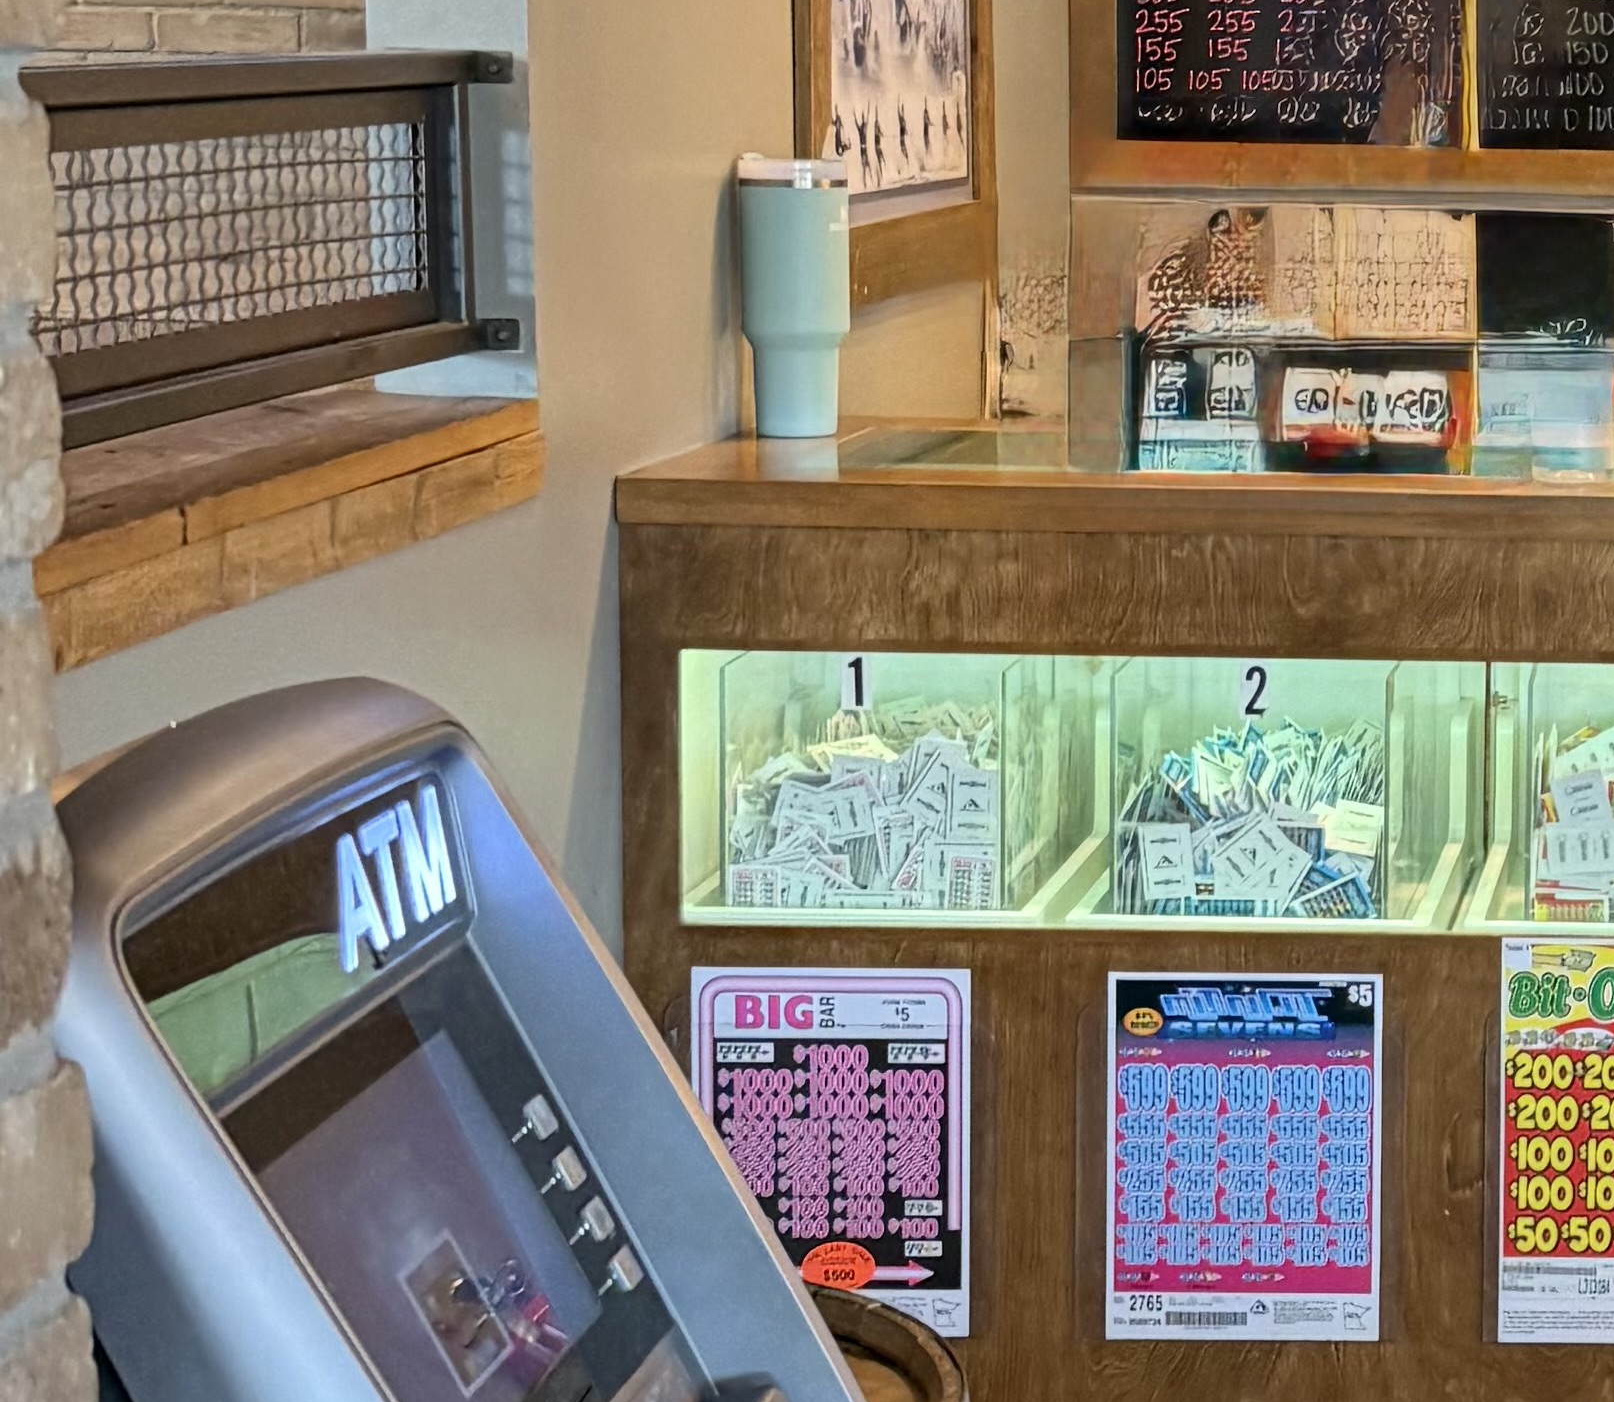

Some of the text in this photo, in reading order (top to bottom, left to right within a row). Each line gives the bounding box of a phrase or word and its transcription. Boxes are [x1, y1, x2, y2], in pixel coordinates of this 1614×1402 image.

[847, 657, 865, 707] 1
[1244, 666, 1268, 716] 2
[336, 784, 457, 973] ATM
[735, 995, 813, 1030] BIG
[819, 996, 836, 1028] BAR
[1347, 984, 1373, 1007] $5
[1169, 1021, 1321, 1037] SEVENS
[1506, 1053, 1574, 1090] $200
[1129, 1295, 1163, 1312] 2765
